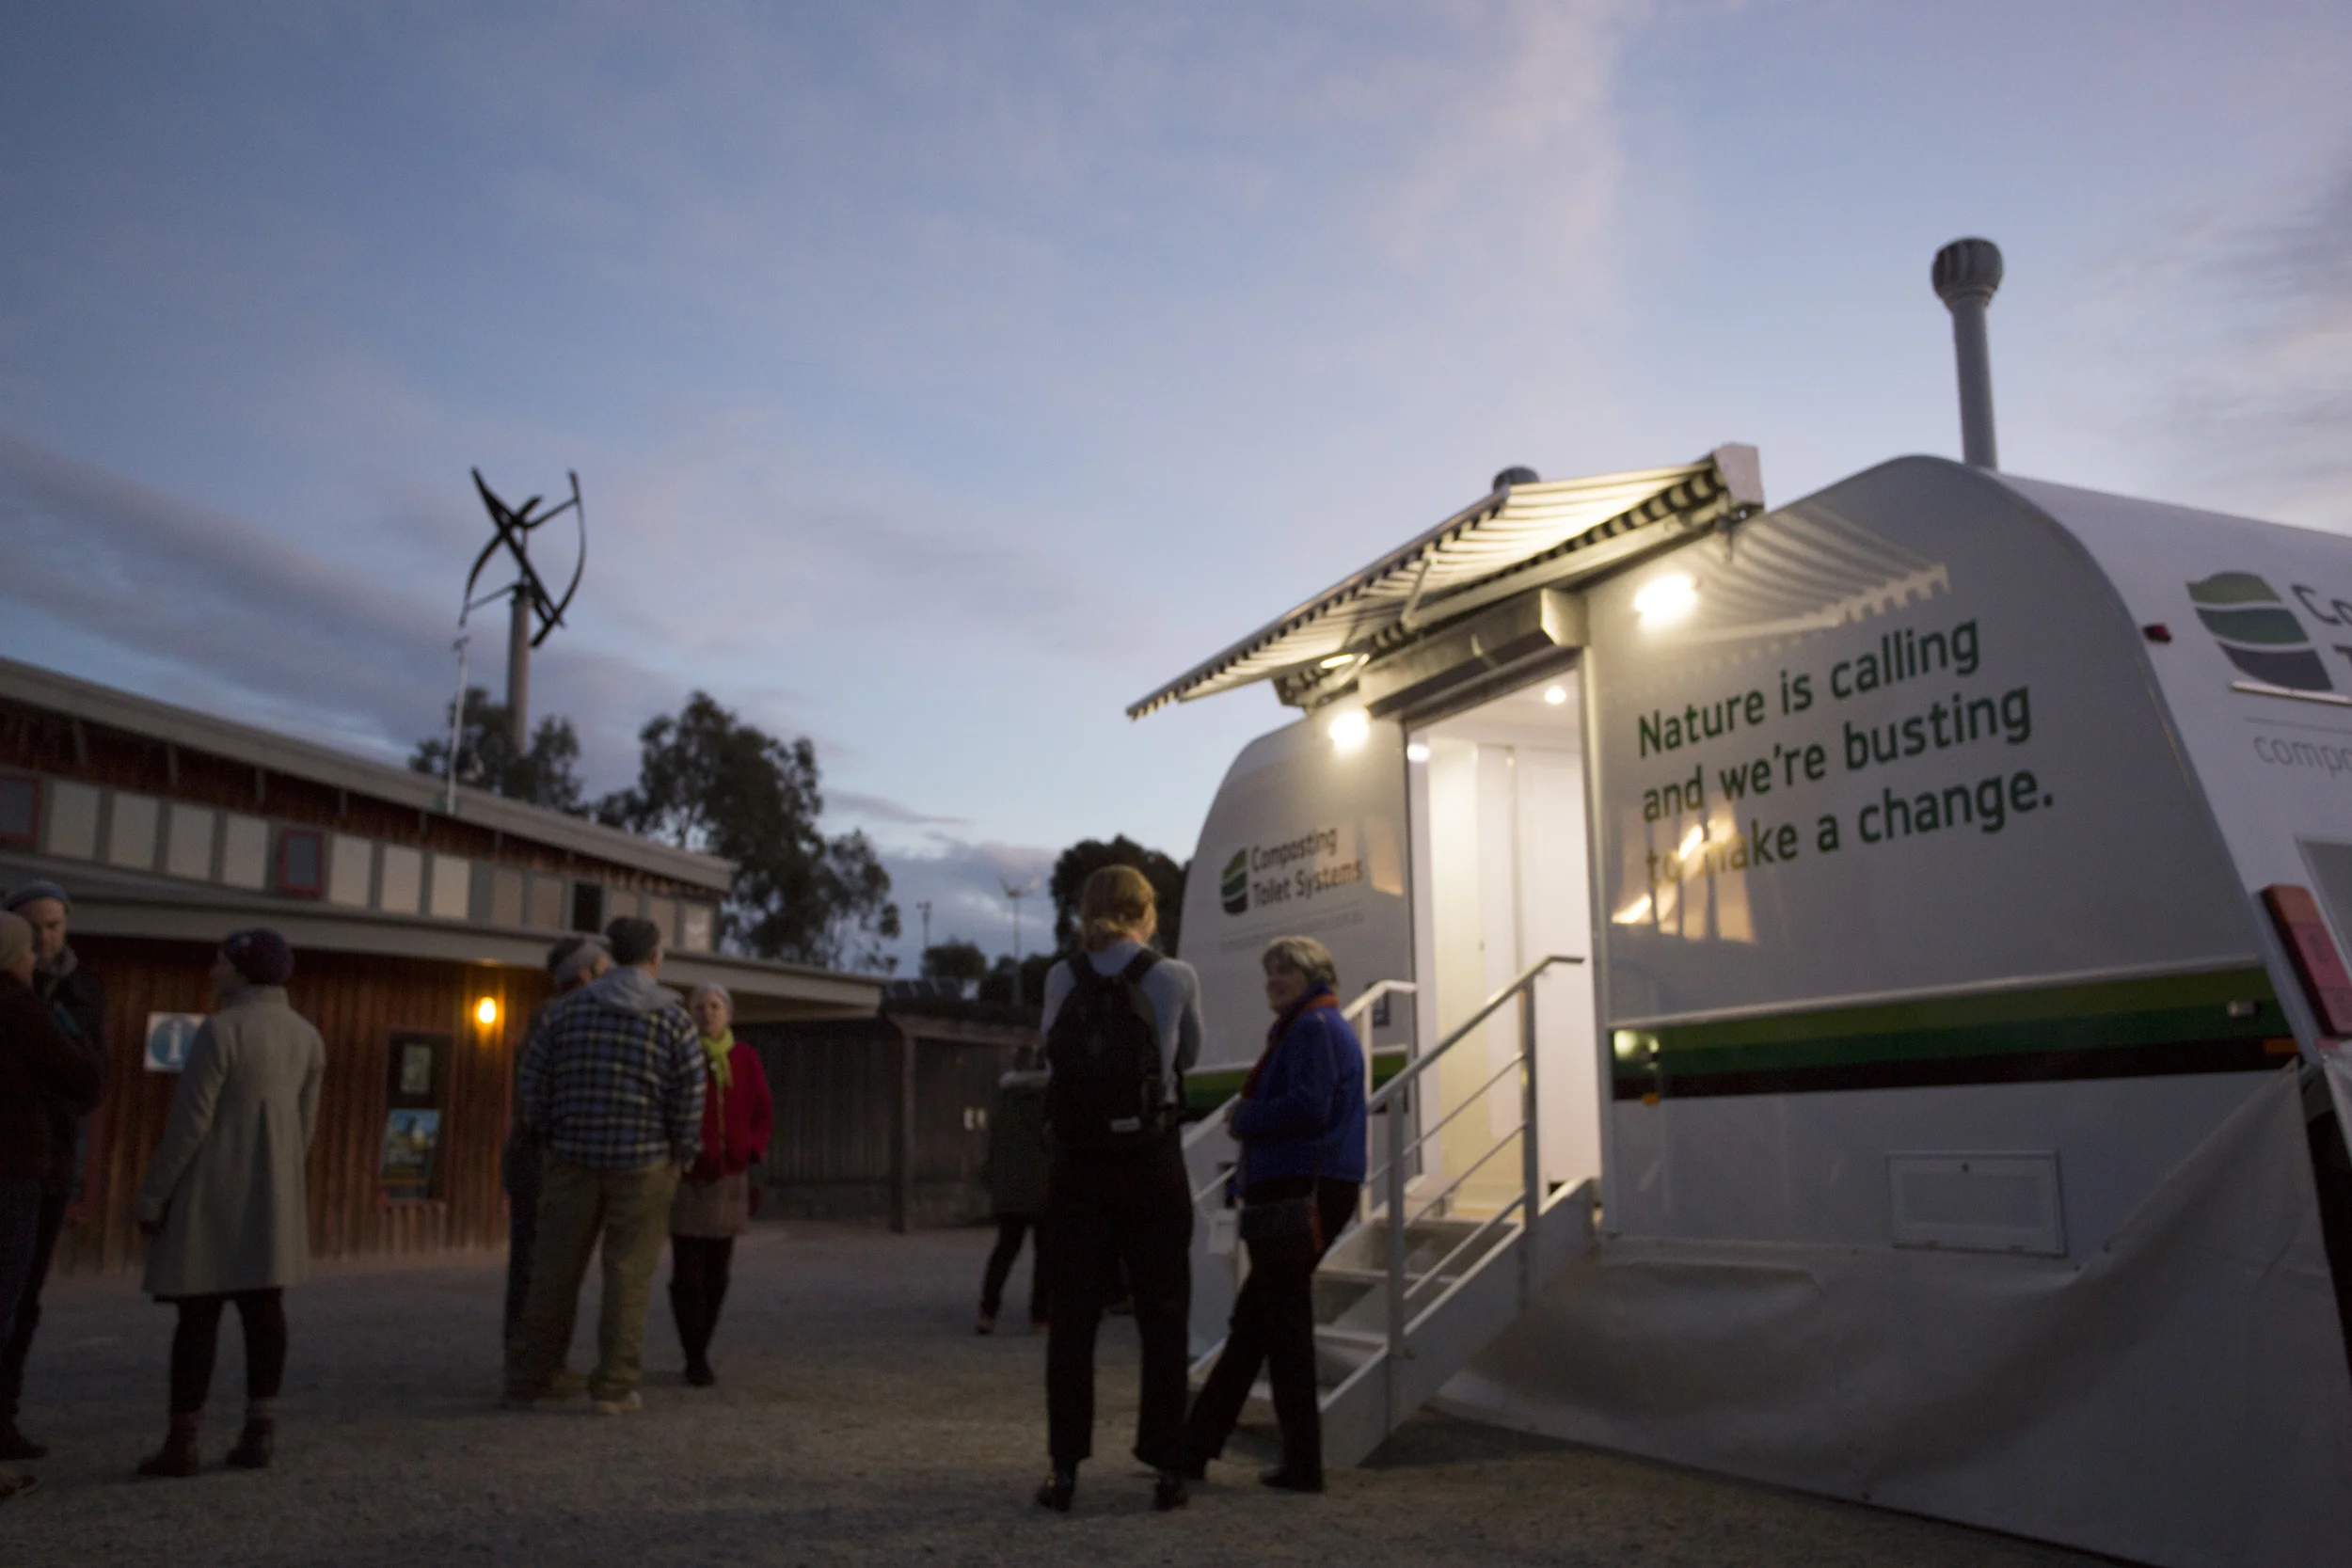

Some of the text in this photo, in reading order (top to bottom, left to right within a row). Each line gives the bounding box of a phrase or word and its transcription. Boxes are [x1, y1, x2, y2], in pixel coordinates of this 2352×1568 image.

[1639, 618, 1981, 758] Nature is calling
[1644, 686, 2032, 823] and we're busting
[1252, 828, 1338, 872] Composting
[1817, 814, 1840, 855] a
[1859, 770, 2054, 845] change.
[1253, 860, 1363, 908] Toilet Systems
